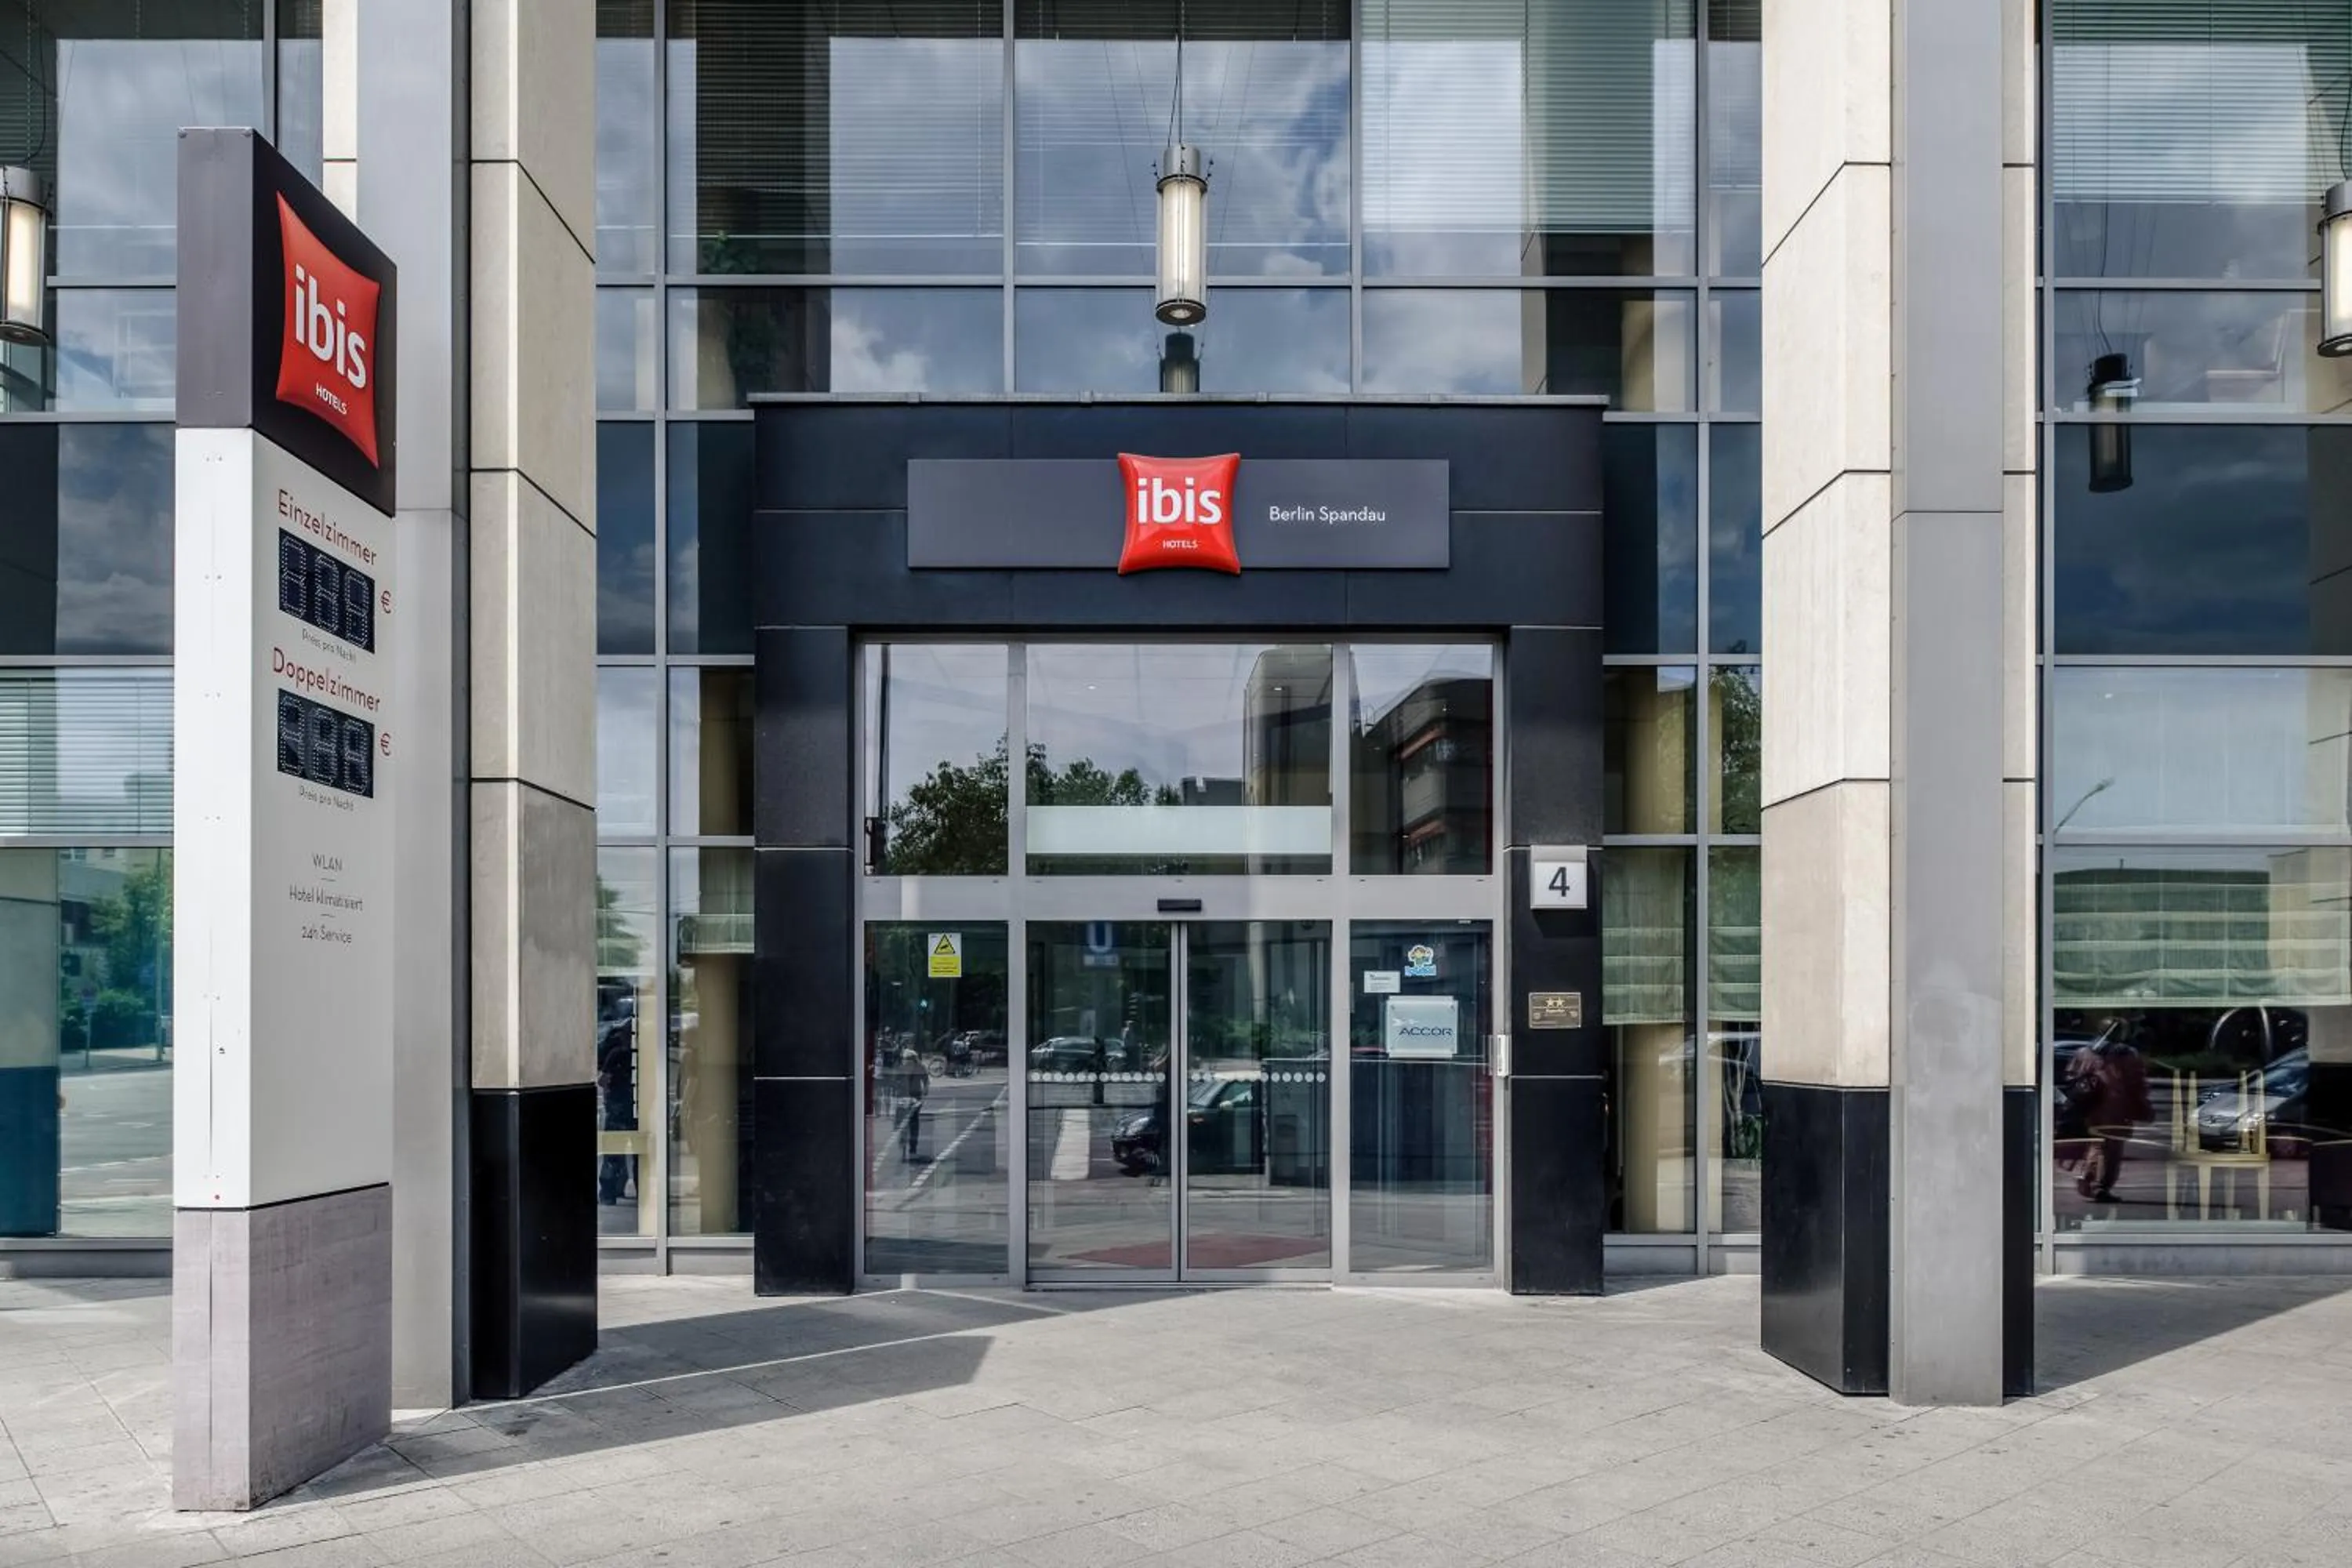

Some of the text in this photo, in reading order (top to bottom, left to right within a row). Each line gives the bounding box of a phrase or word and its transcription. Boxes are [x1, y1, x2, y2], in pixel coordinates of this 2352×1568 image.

[295, 263, 367, 389] ibis
[315, 383, 347, 416] HOTELS
[1138, 477, 1222, 525] ibis
[278, 488, 377, 565] Einzelzimmer
[1269, 506, 1386, 526] Berlin Spandau
[1163, 539, 1199, 550] HOTELS
[380, 590, 392, 615] €
[274, 647, 380, 712] Doppelzimmer
[380, 732, 392, 757] €
[312, 853, 343, 871] WLAN
[289, 884, 314, 902] Hotel
[1548, 866, 1570, 897] 4
[301, 924, 352, 944] 24h Service
[1398, 1025, 1453, 1036] ACCOR
